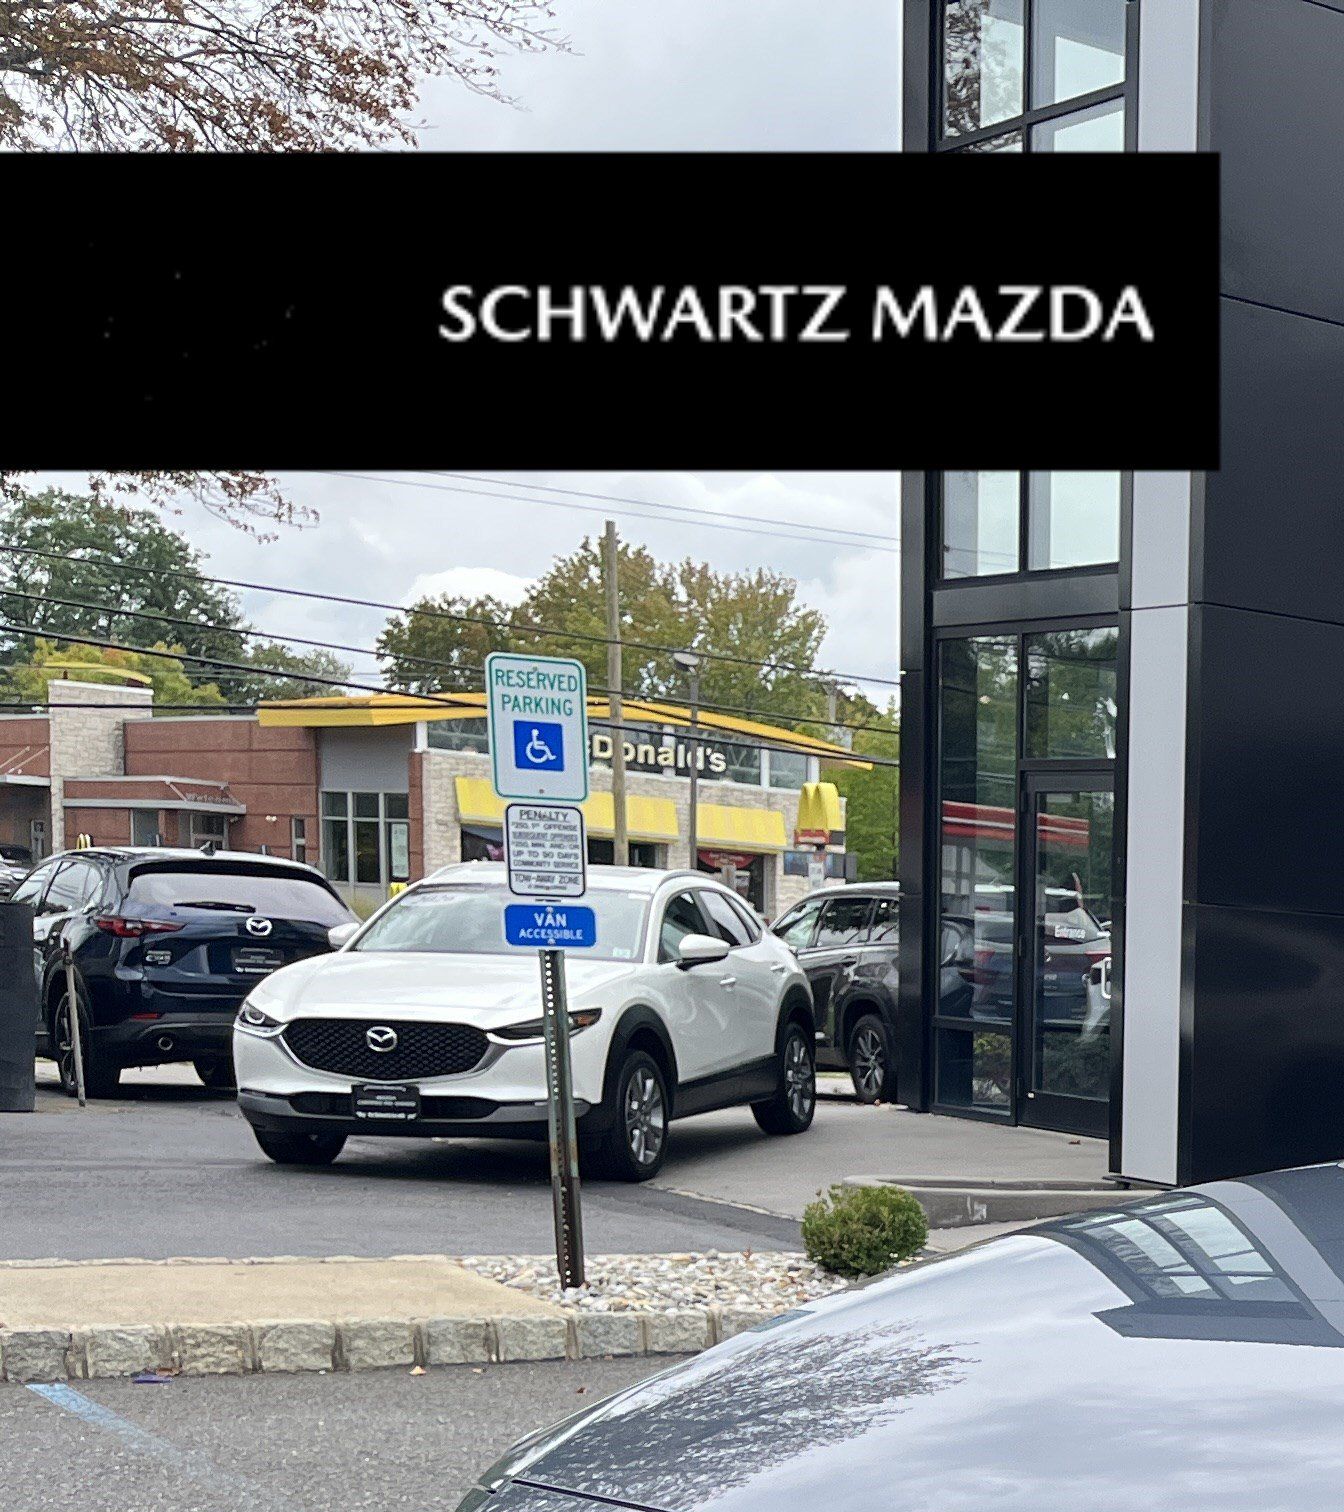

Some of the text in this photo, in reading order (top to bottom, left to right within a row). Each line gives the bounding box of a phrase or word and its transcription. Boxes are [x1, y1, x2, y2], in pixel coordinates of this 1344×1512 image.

[495, 668, 578, 693] RESERVED
[501, 693, 574, 717] PARKING
[519, 809, 569, 822] PENALTY
[533, 912, 568, 928] VAN
[518, 928, 583, 940] ACCESSIBLE
